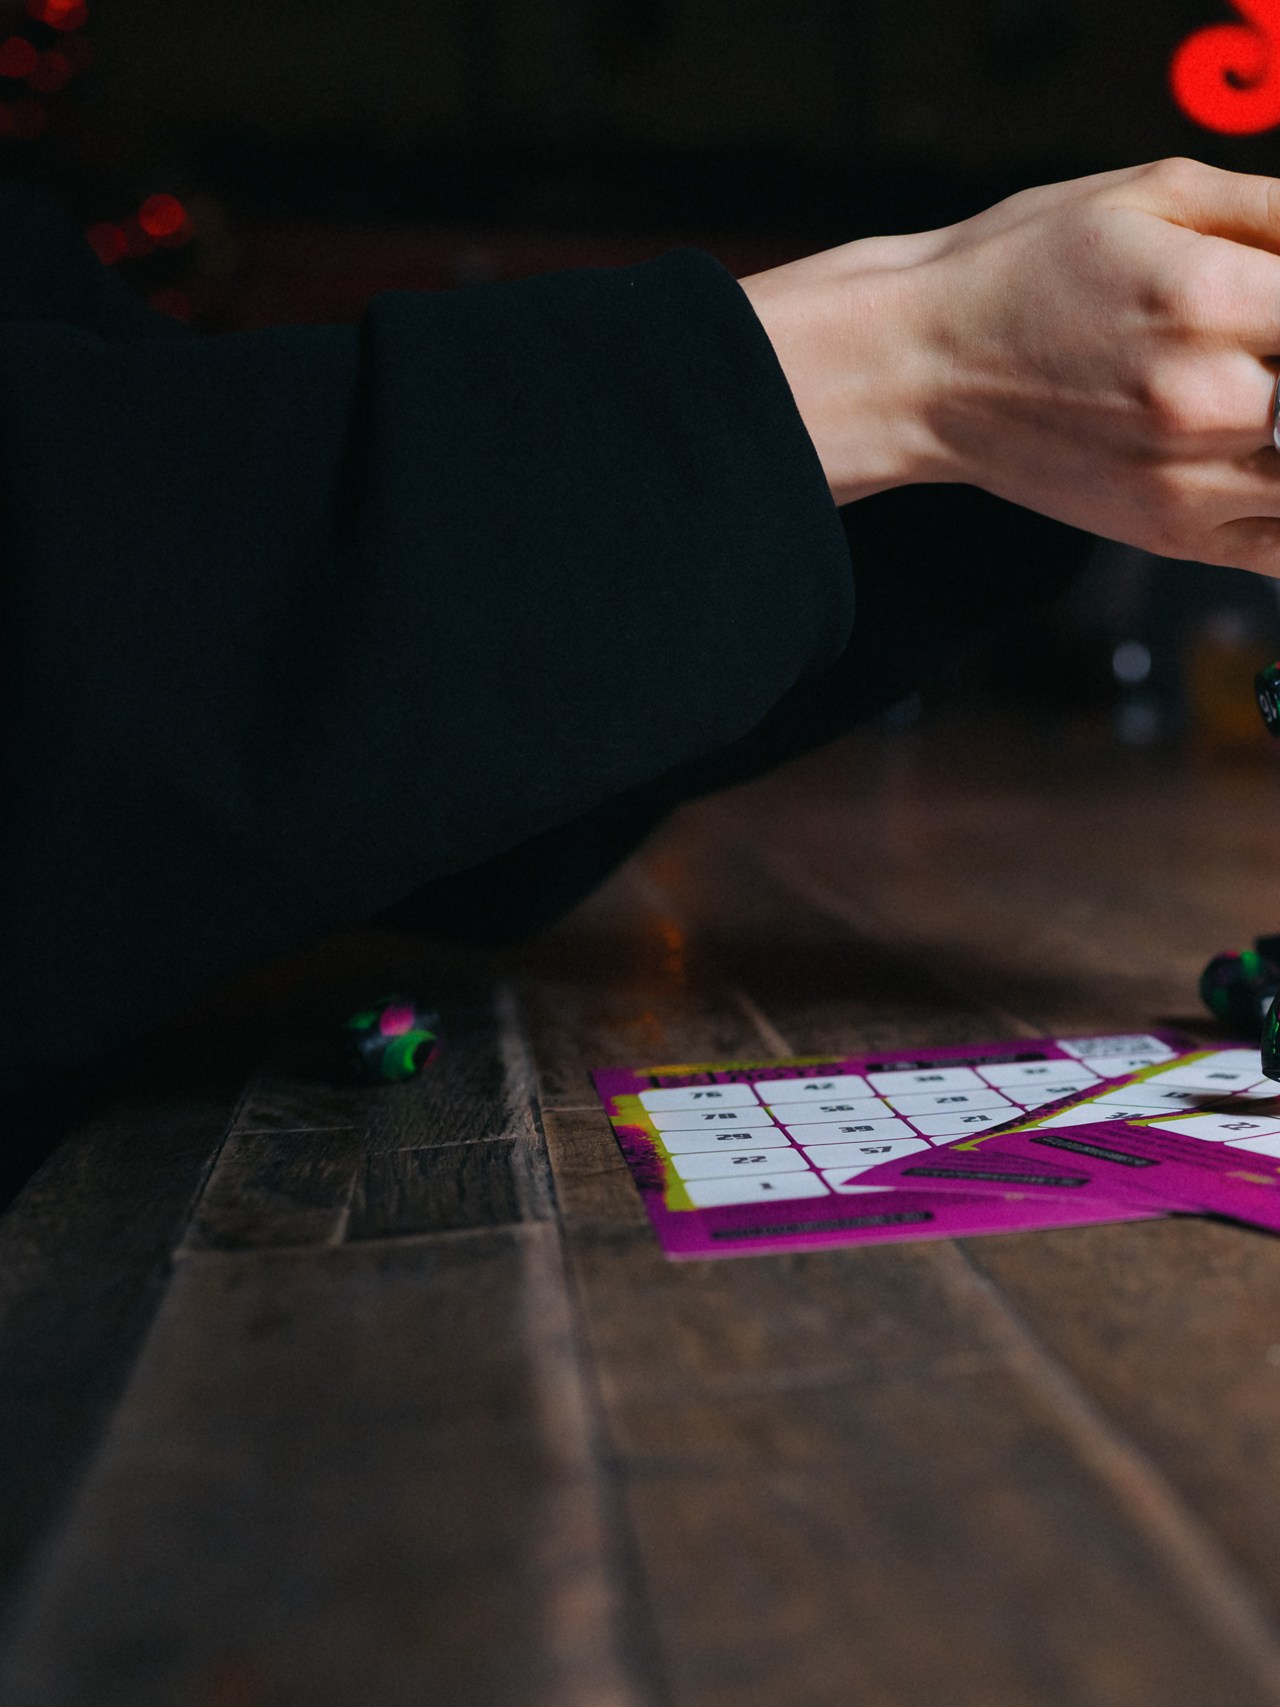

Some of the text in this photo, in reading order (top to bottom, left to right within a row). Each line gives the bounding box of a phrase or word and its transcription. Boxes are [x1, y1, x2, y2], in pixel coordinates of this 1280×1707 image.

[715, 1114, 992, 1141] 29 39 21
[1219, 1121, 1260, 1131] 22
[731, 1145, 893, 1164] 22 57
